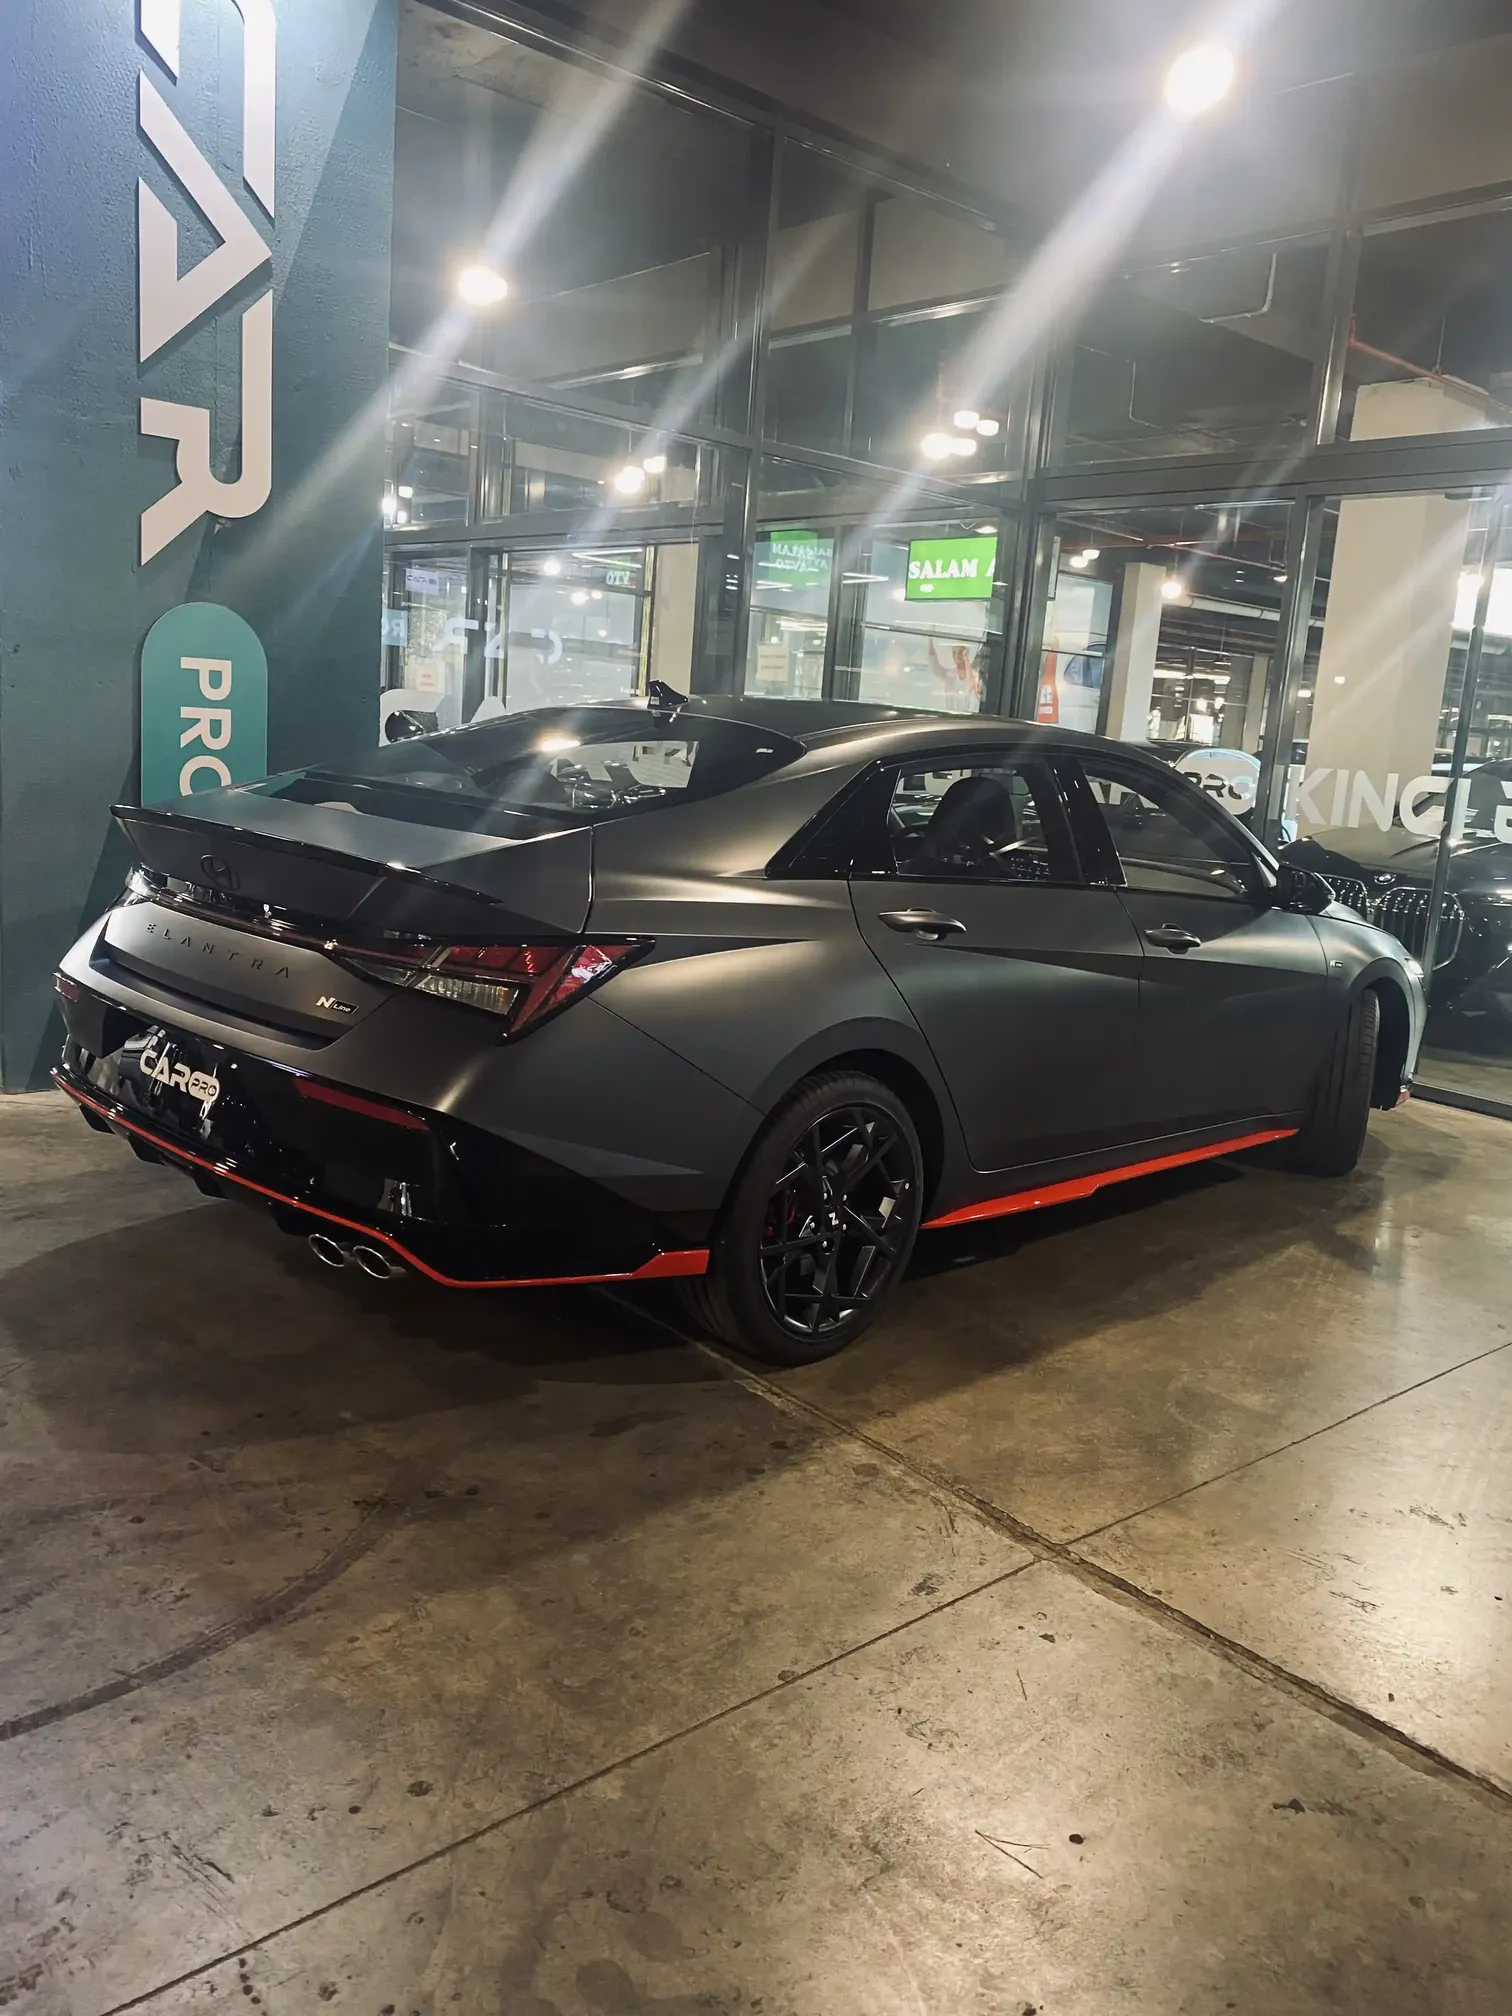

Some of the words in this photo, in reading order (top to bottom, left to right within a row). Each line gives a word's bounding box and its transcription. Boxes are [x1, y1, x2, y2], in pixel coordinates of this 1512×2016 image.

[139, 0, 275, 566] CAR
[908, 557, 979, 580] SALAM
[146, 922, 290, 979] ELANTRA
[315, 995, 336, 1009] N
[140, 1047, 191, 1093] CAR
[191, 1077, 218, 1097] PRO
